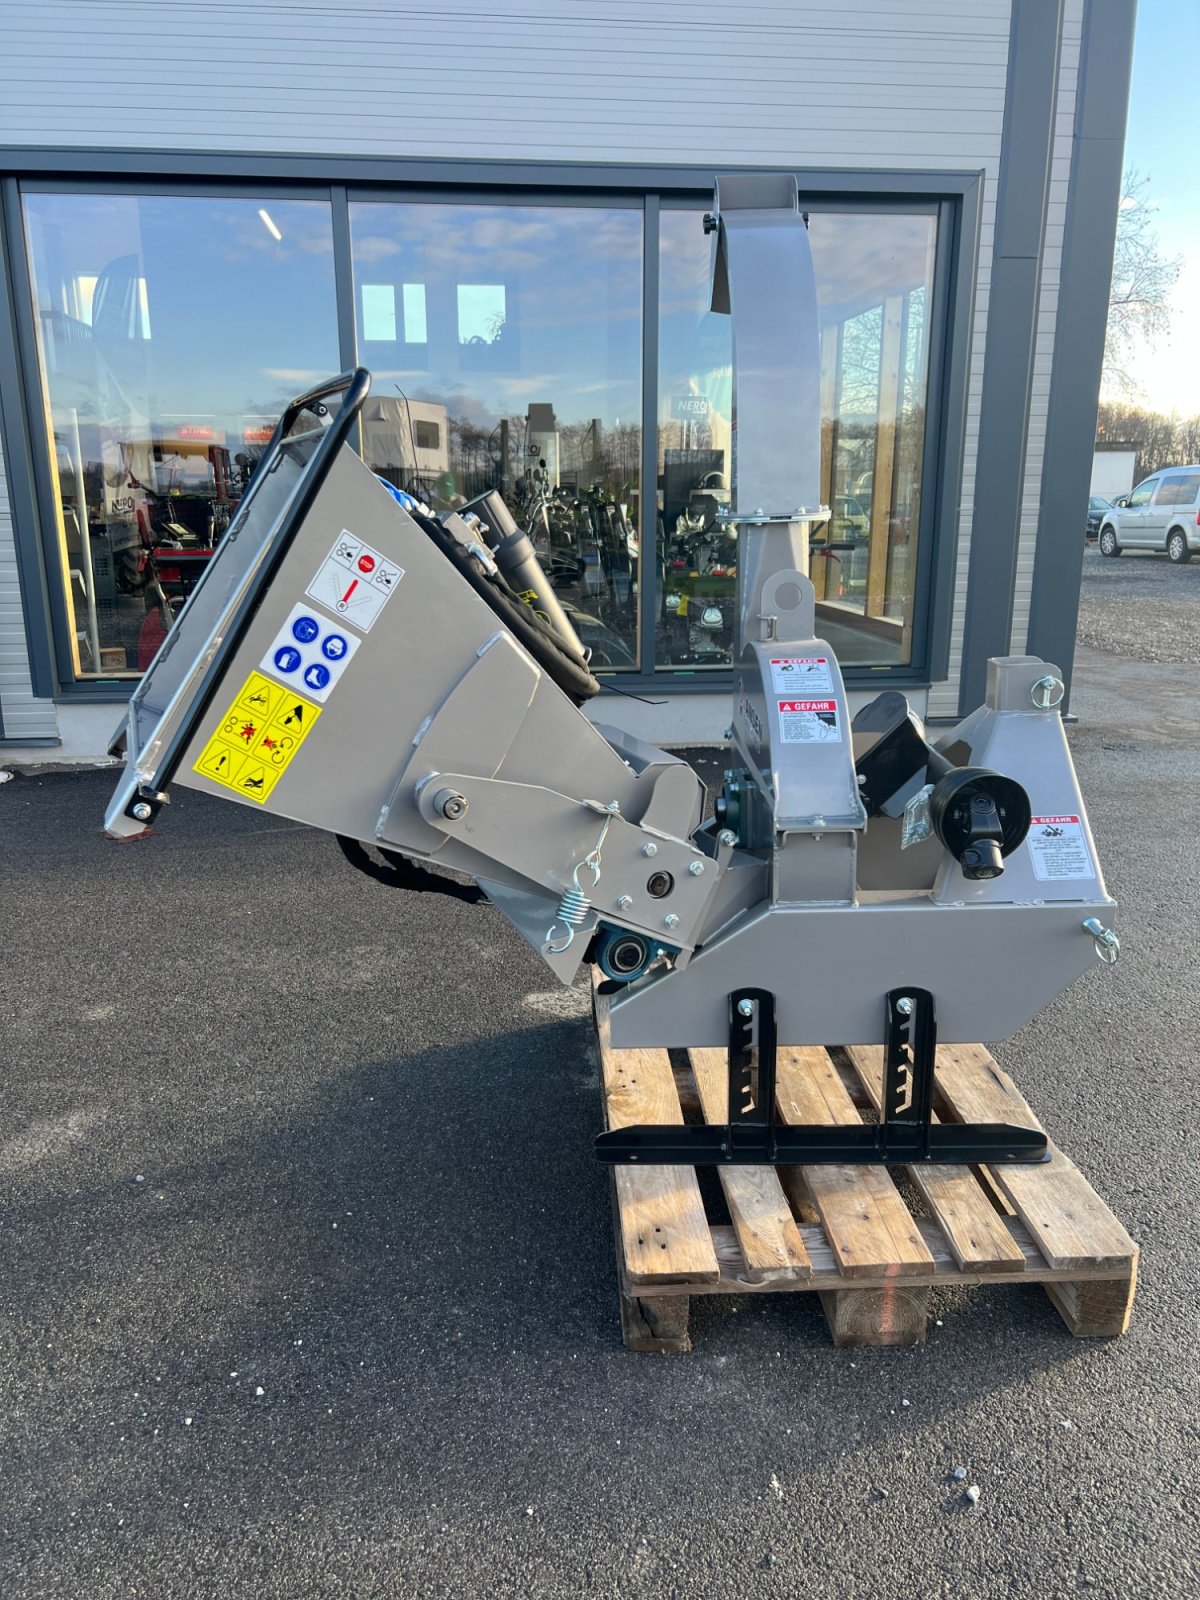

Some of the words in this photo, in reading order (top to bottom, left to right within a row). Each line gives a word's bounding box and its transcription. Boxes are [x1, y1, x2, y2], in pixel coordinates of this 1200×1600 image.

[678, 400, 706, 411] NERO
[359, 558, 373, 569] STOP
[794, 702, 830, 711] GEFAHR
[1039, 816, 1072, 824] GEFAHR
